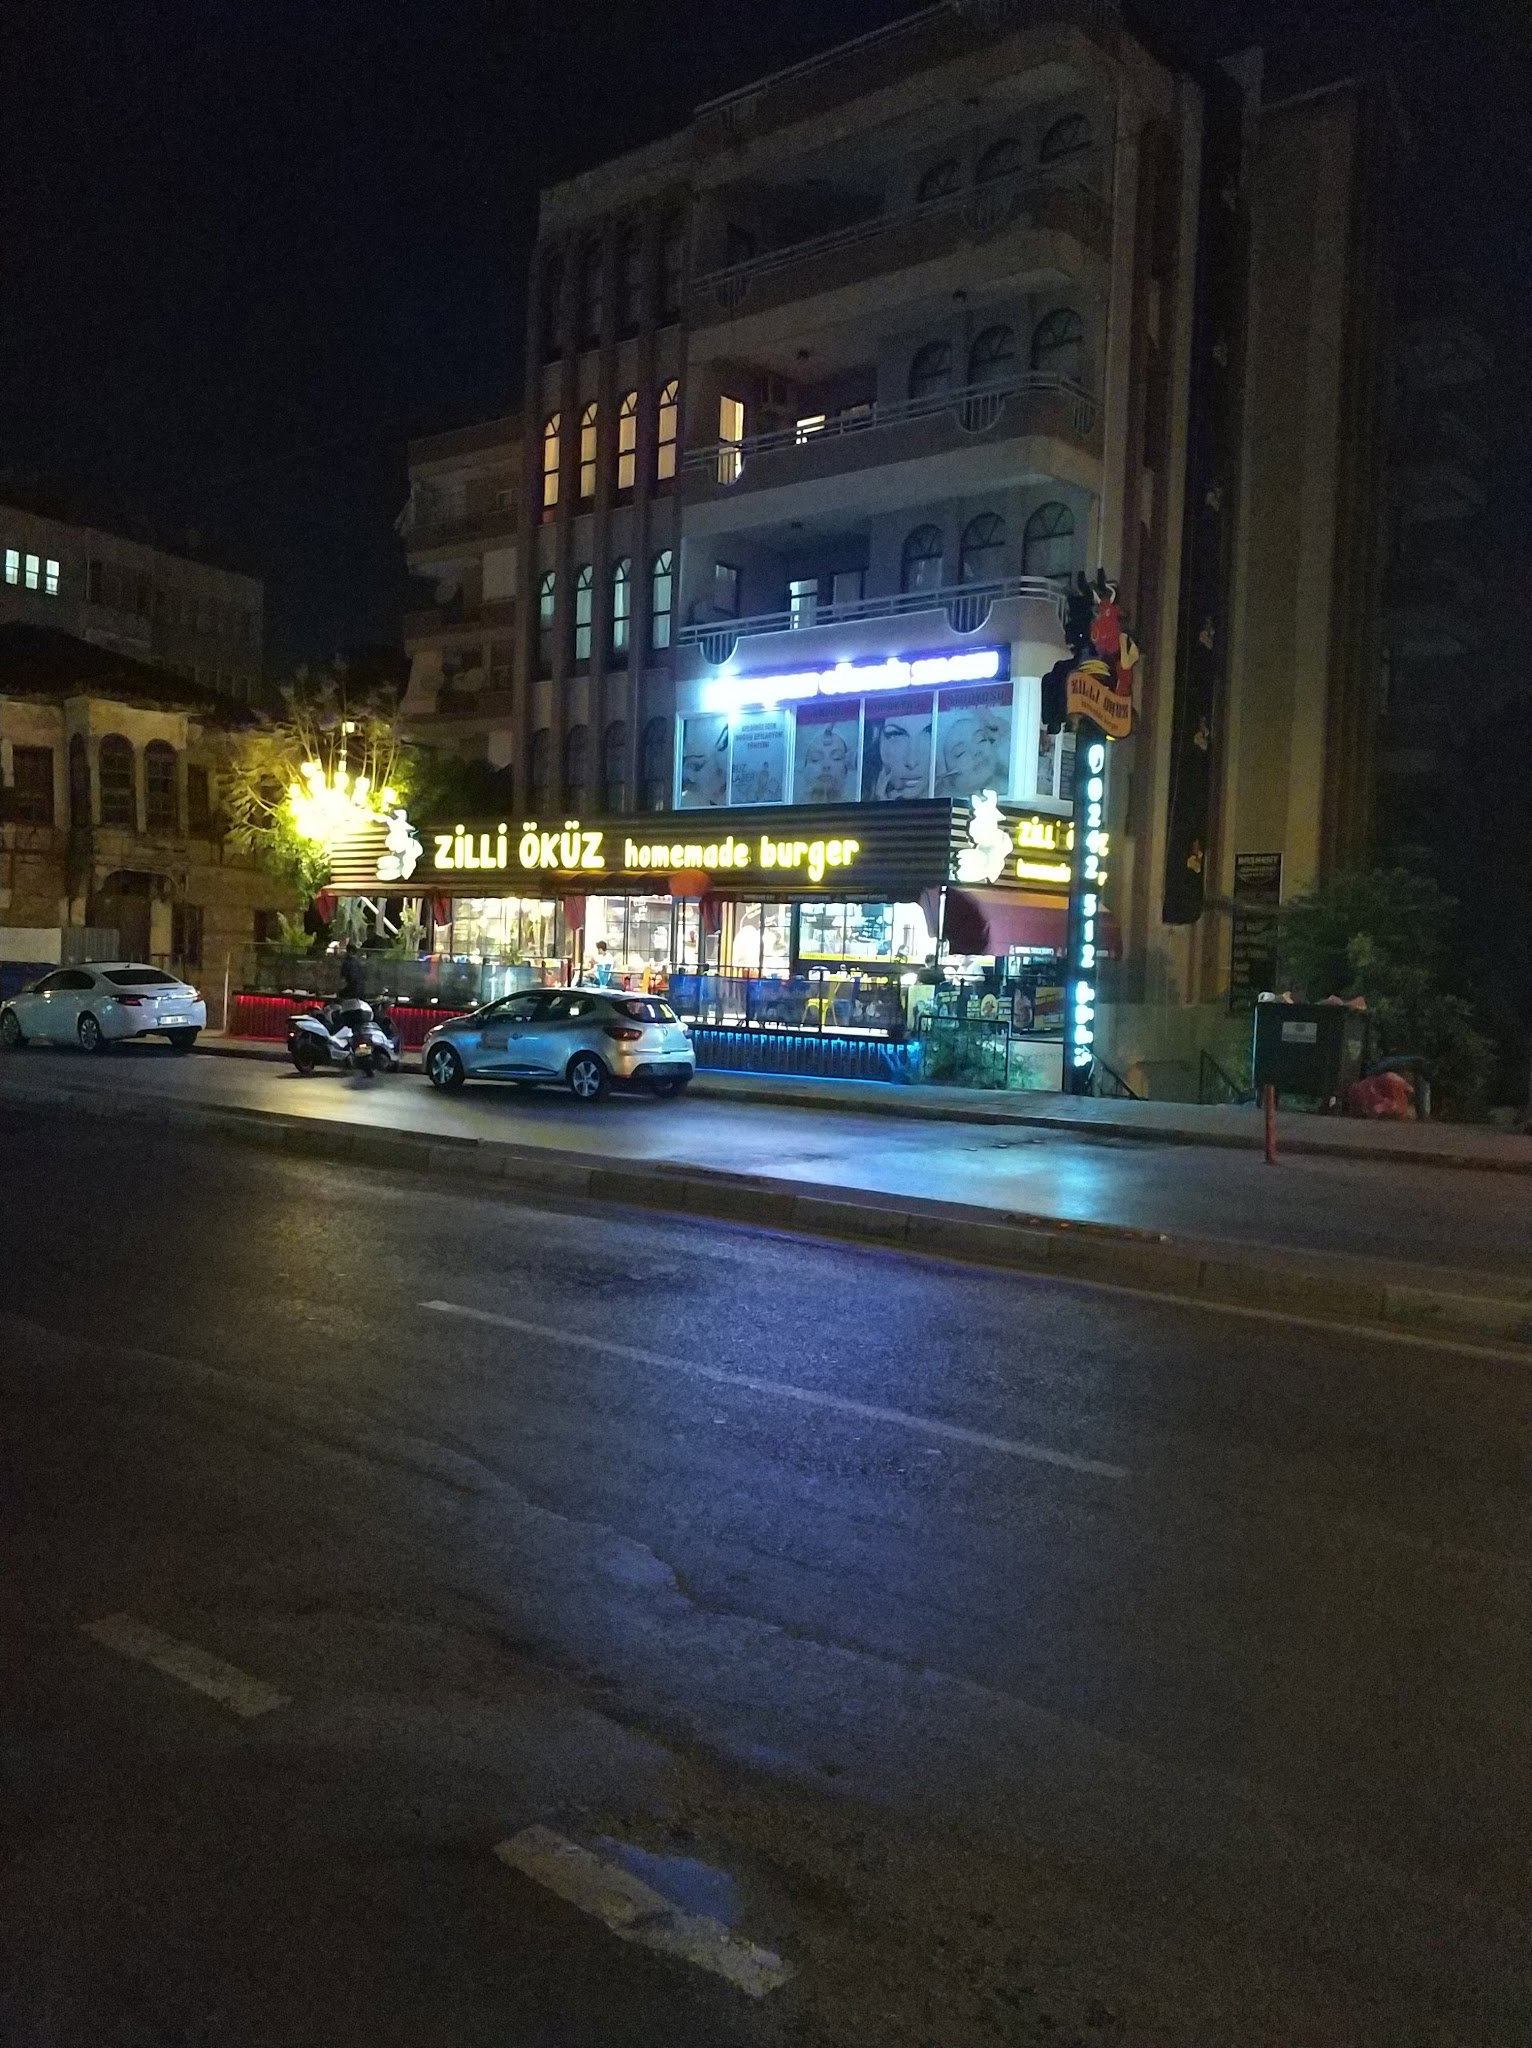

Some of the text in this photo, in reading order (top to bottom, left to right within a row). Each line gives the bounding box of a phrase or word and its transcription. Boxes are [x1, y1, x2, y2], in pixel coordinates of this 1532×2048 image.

[519, 820, 606, 869] ÖKÜZ
[625, 836, 749, 868] homemade
[760, 835, 860, 882] burger
